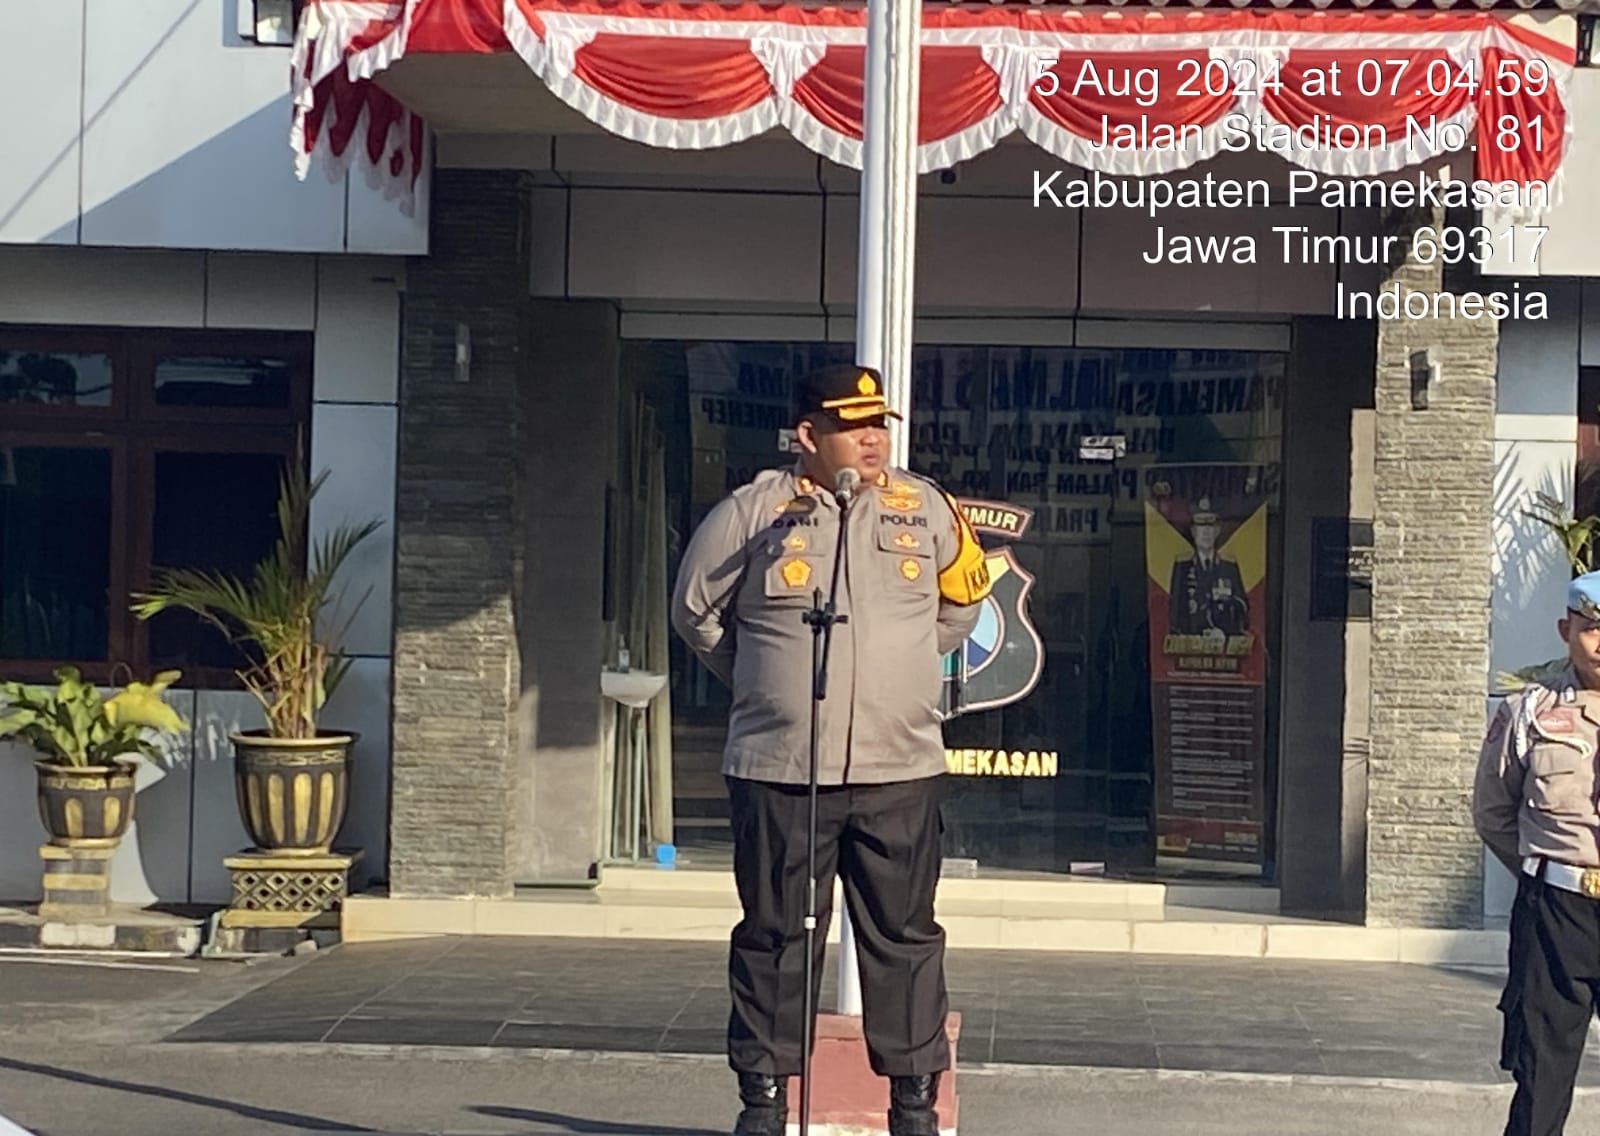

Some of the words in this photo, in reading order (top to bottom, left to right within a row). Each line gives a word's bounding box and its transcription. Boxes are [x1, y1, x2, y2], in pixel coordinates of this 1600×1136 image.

[772, 516, 819, 529] DANI
[879, 514, 928, 528] POLRI
[944, 749, 1058, 776] MEKASAN
